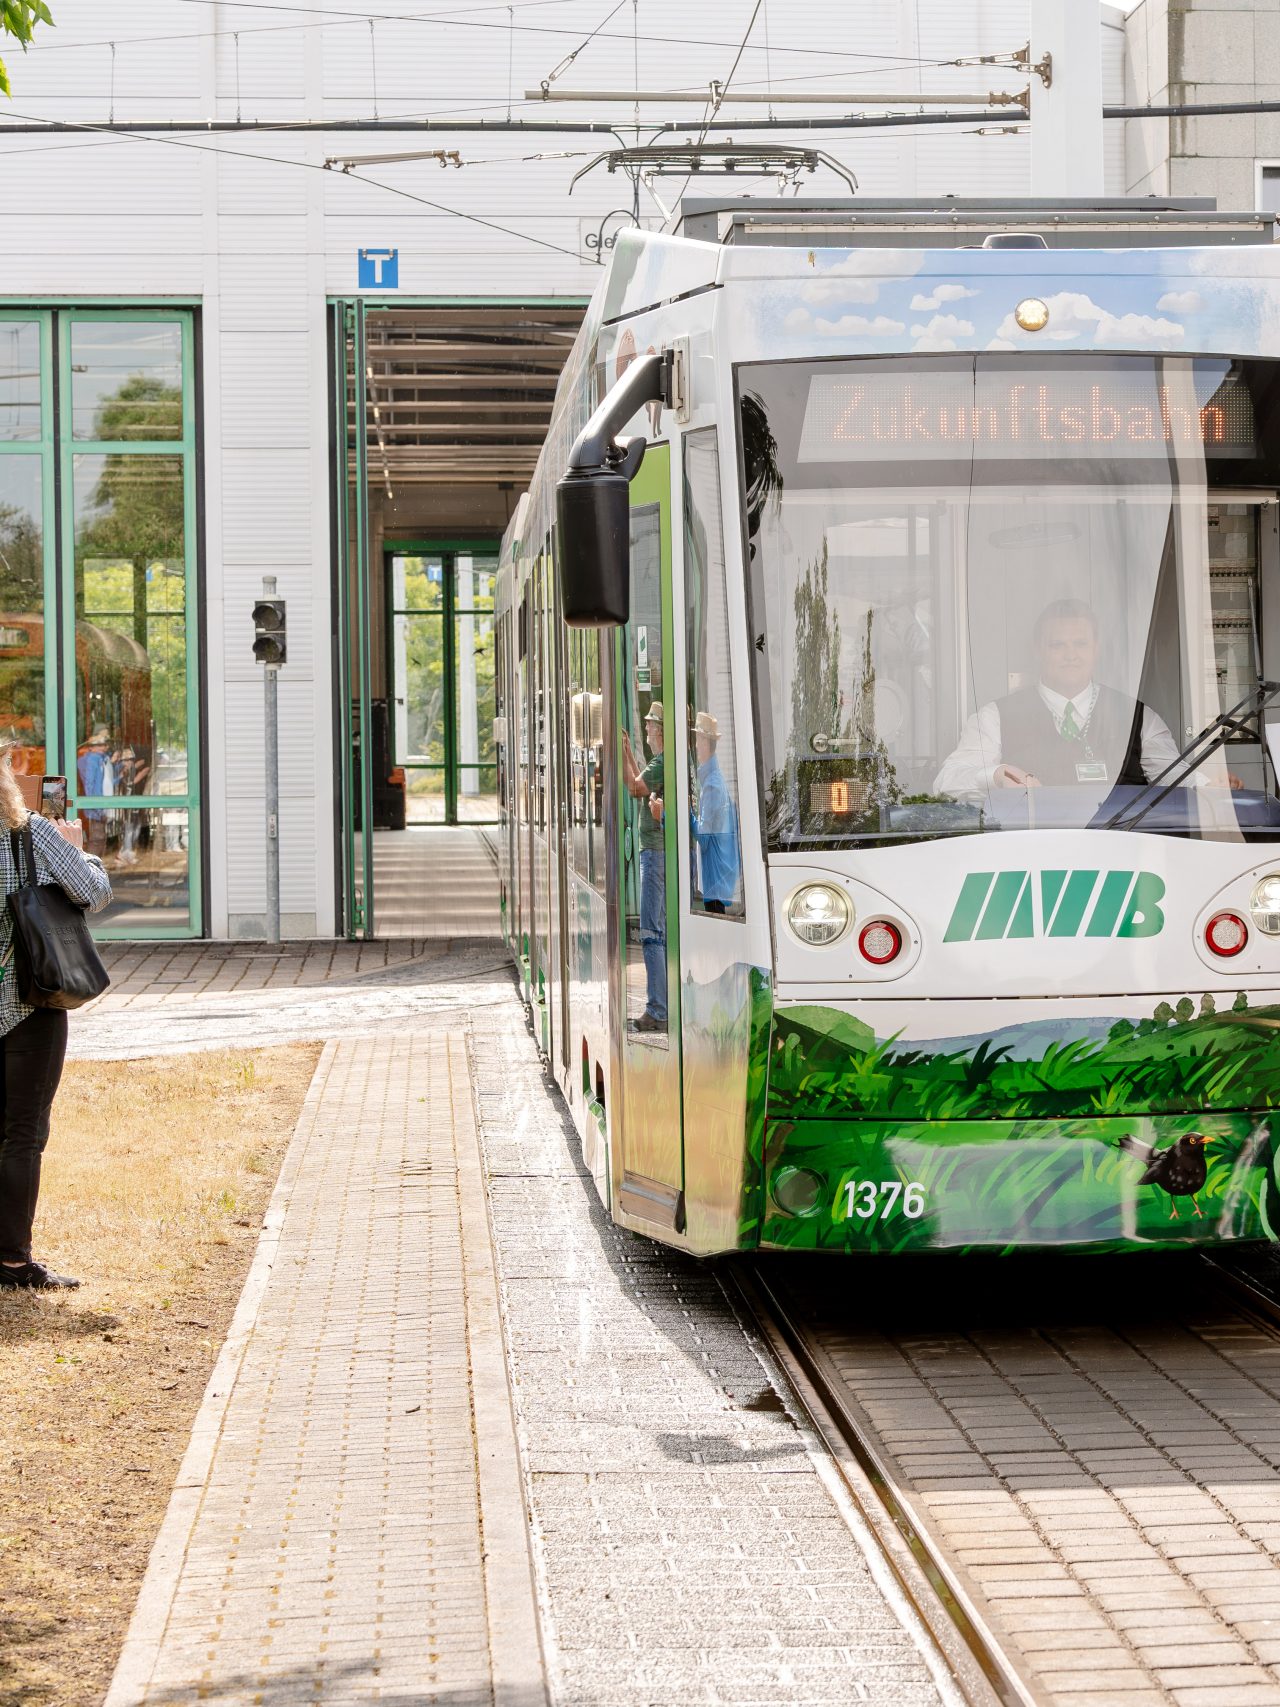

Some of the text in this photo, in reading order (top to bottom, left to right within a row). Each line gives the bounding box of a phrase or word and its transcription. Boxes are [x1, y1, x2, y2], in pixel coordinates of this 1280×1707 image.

[365, 253, 392, 284] T
[832, 384, 1225, 439] Zukunftsbahn
[831, 782, 848, 812] 0
[942, 869, 1166, 943] MVB
[844, 1181, 925, 1219] 1376
